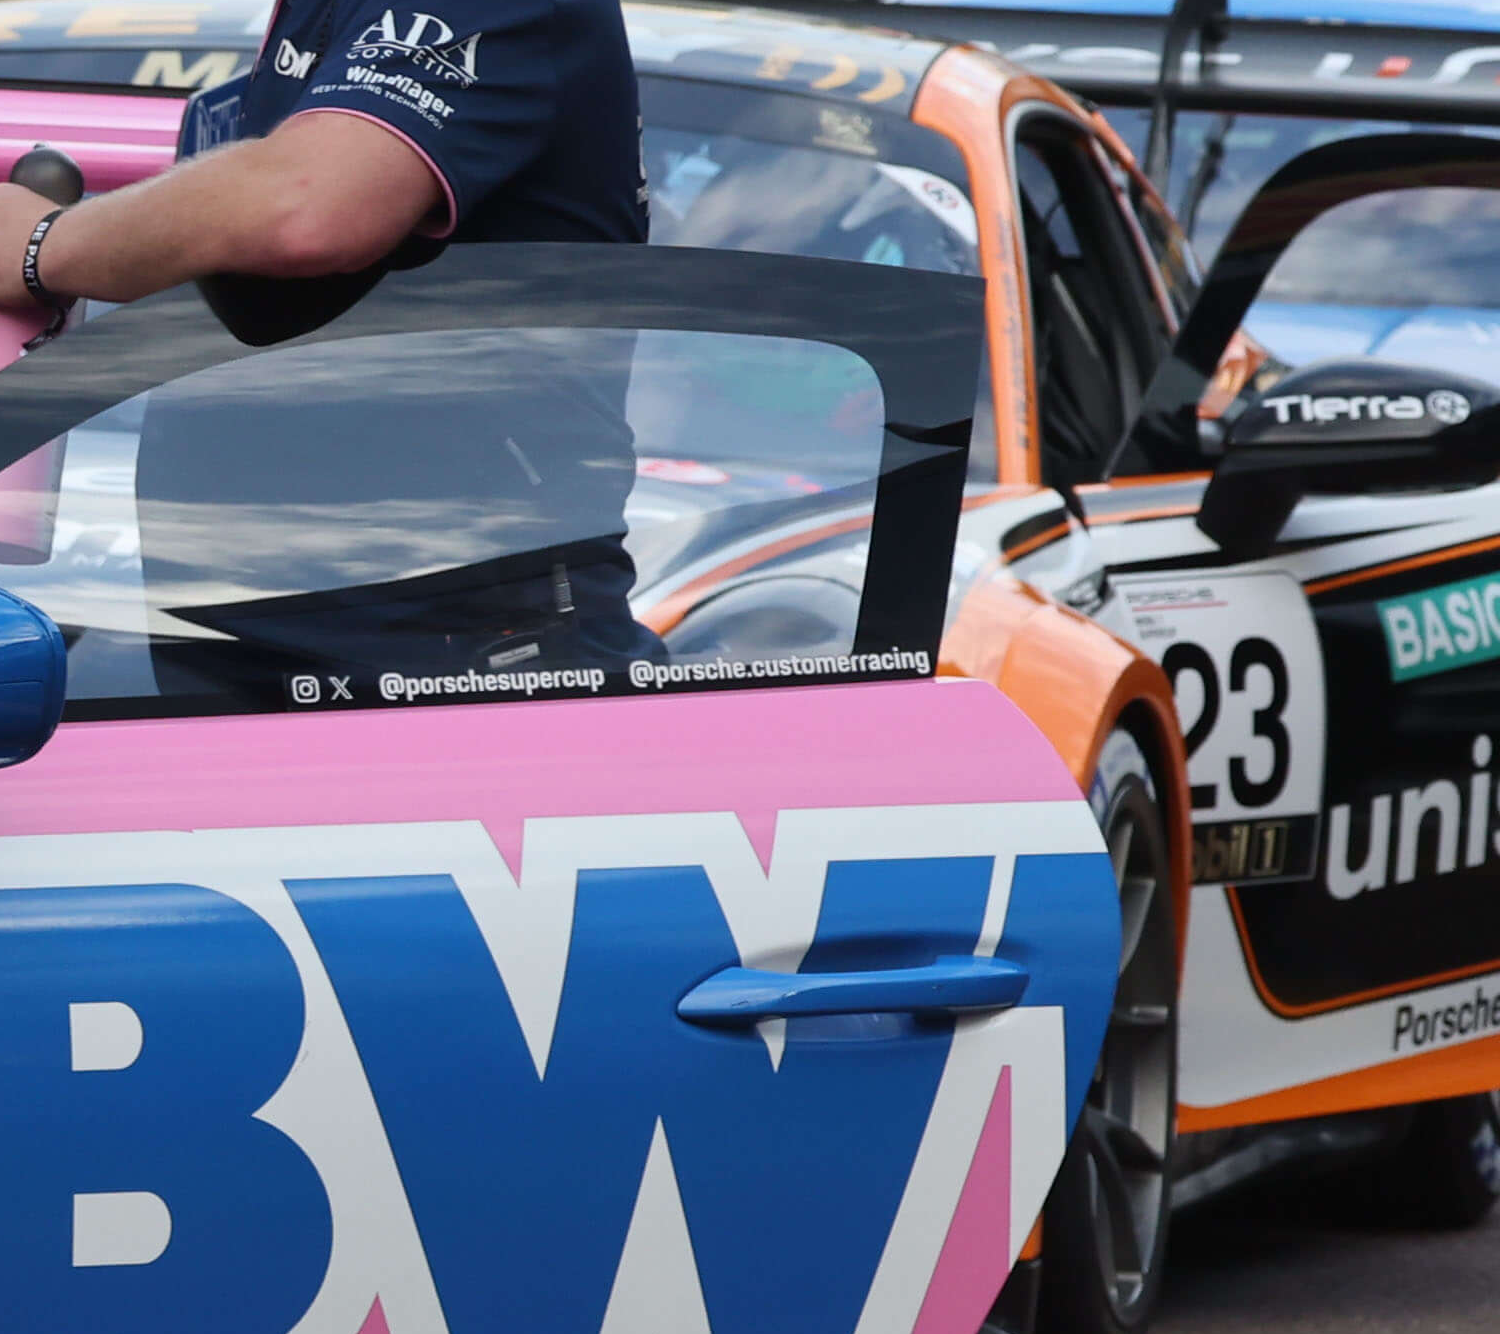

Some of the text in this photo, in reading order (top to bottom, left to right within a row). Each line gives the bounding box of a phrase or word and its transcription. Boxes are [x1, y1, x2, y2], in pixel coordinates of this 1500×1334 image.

[352, 8, 482, 82] ADA
[1262, 393, 1425, 424] Tierra
[379, 667, 605, 701] @porschesupercup
[629, 645, 931, 685] @porsche.customerracing
[1161, 636, 1291, 810] 23
[1325, 733, 1500, 901] uni
